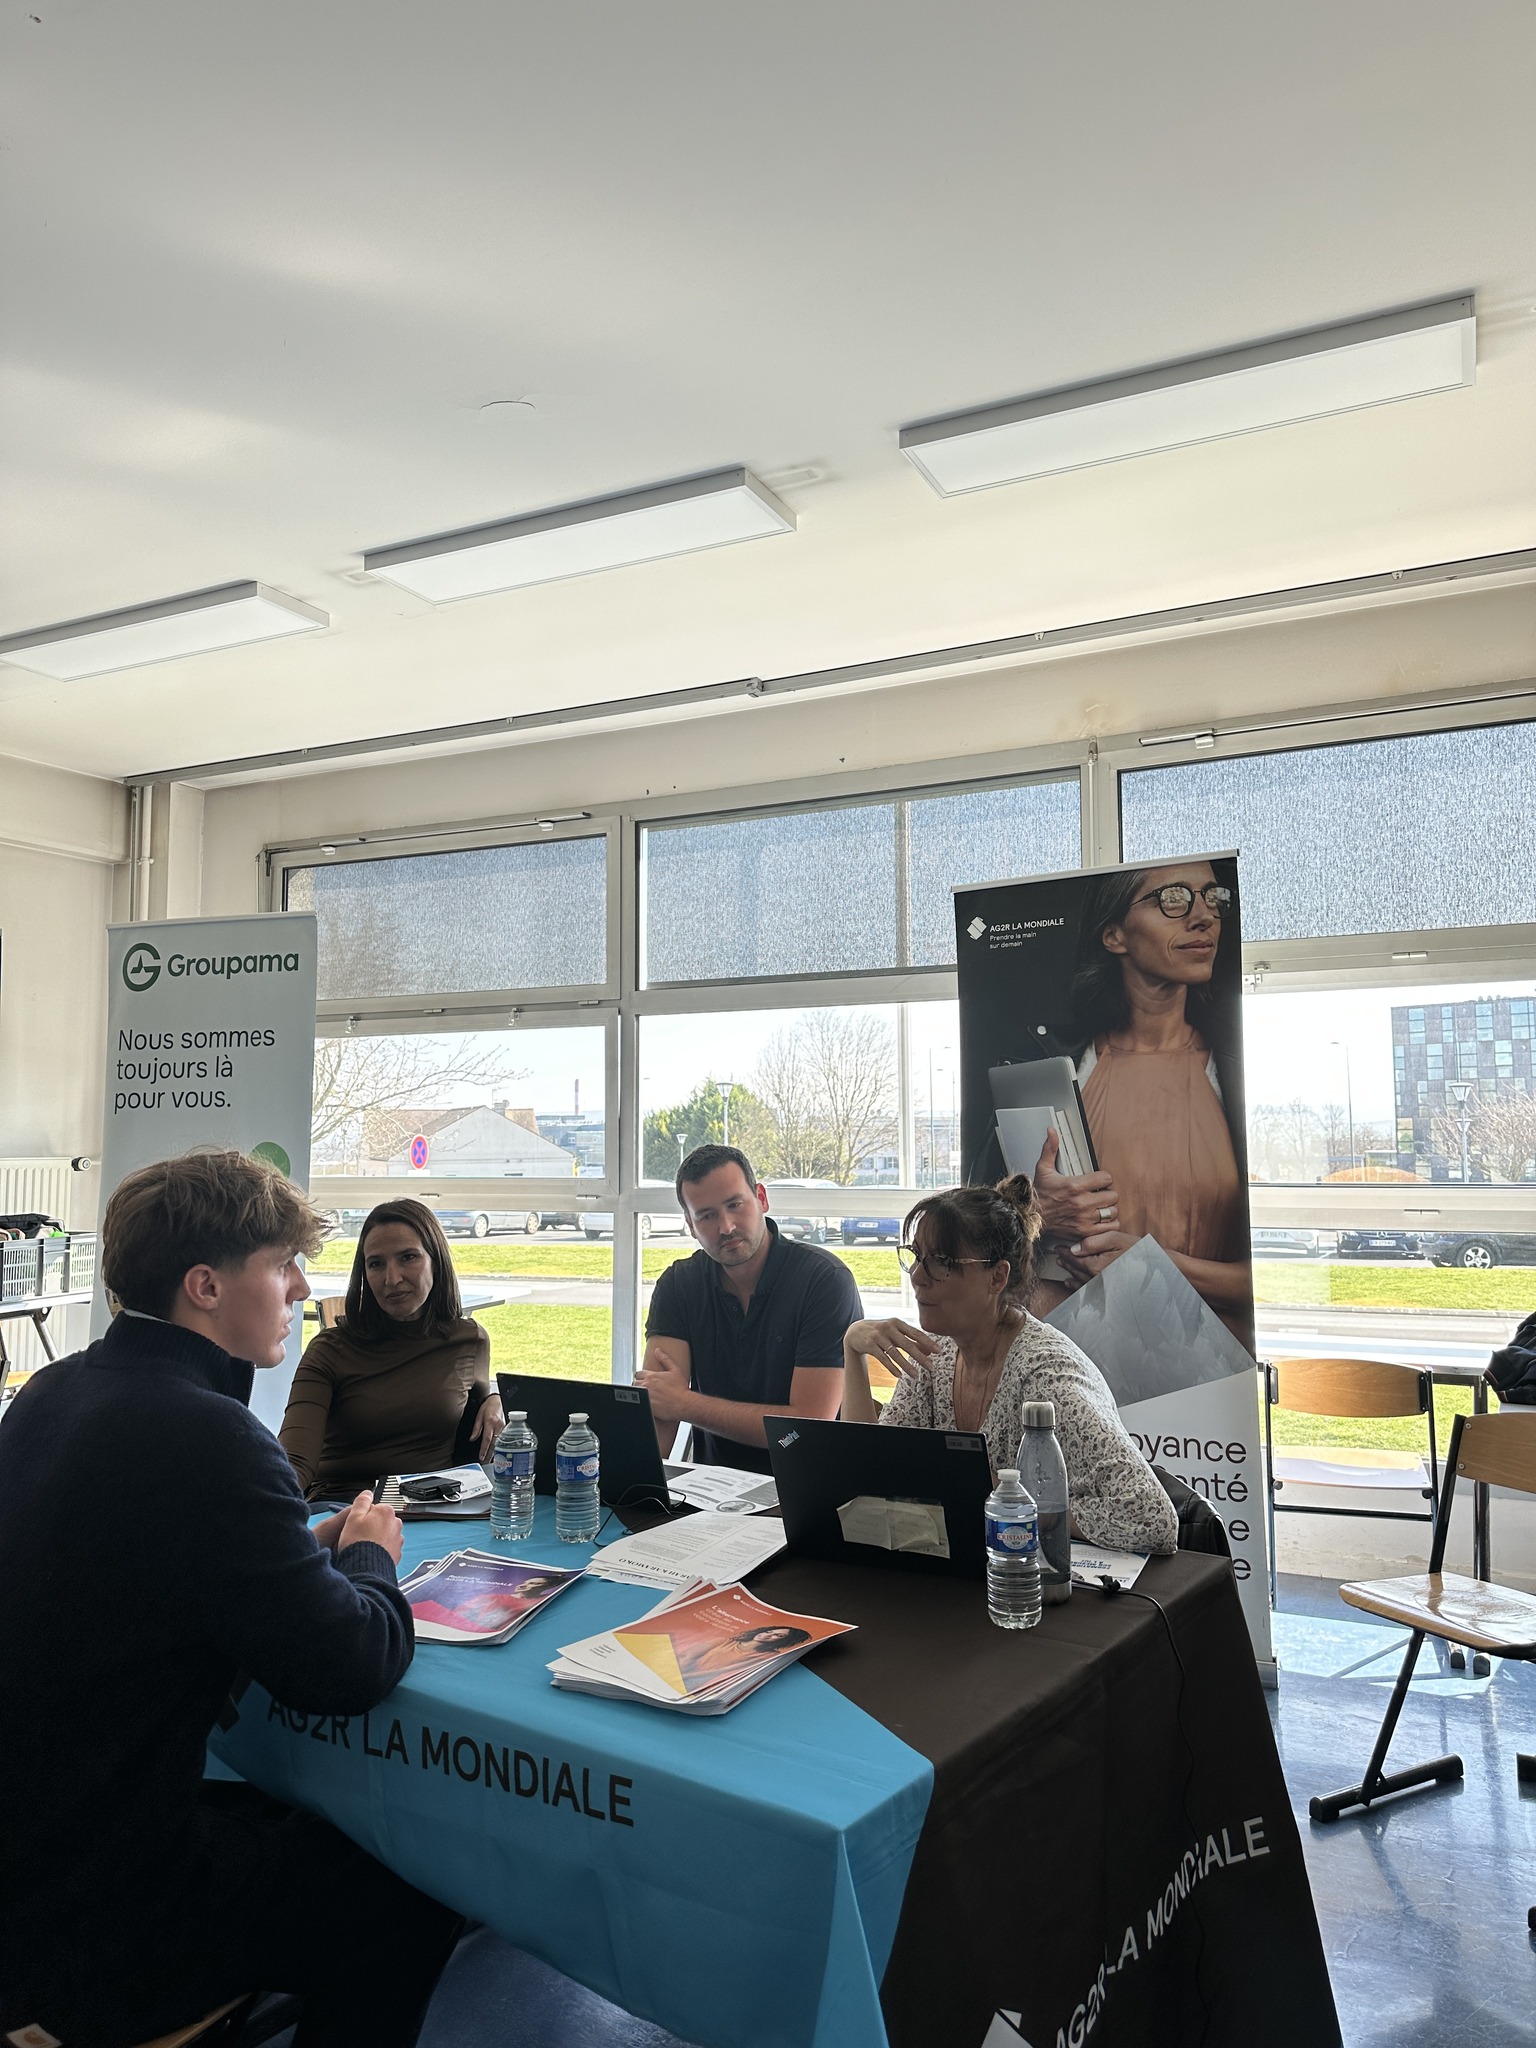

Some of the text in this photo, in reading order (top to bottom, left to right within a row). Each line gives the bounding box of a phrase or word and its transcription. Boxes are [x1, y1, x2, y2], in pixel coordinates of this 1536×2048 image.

[989, 917, 1065, 932] AG2R LA MONDIALE
[167, 953, 300, 980] Groupama
[118, 1029, 275, 1051] Nous sommes
[116, 1054, 233, 1084] toujours là
[114, 1090, 232, 1115] pour vous.
[1129, 1433, 1247, 1464] oyance
[363, 1711, 410, 1766] LA
[421, 1726, 635, 1828] MONDIALE
[1146, 1816, 1271, 1950] MONDIALE
